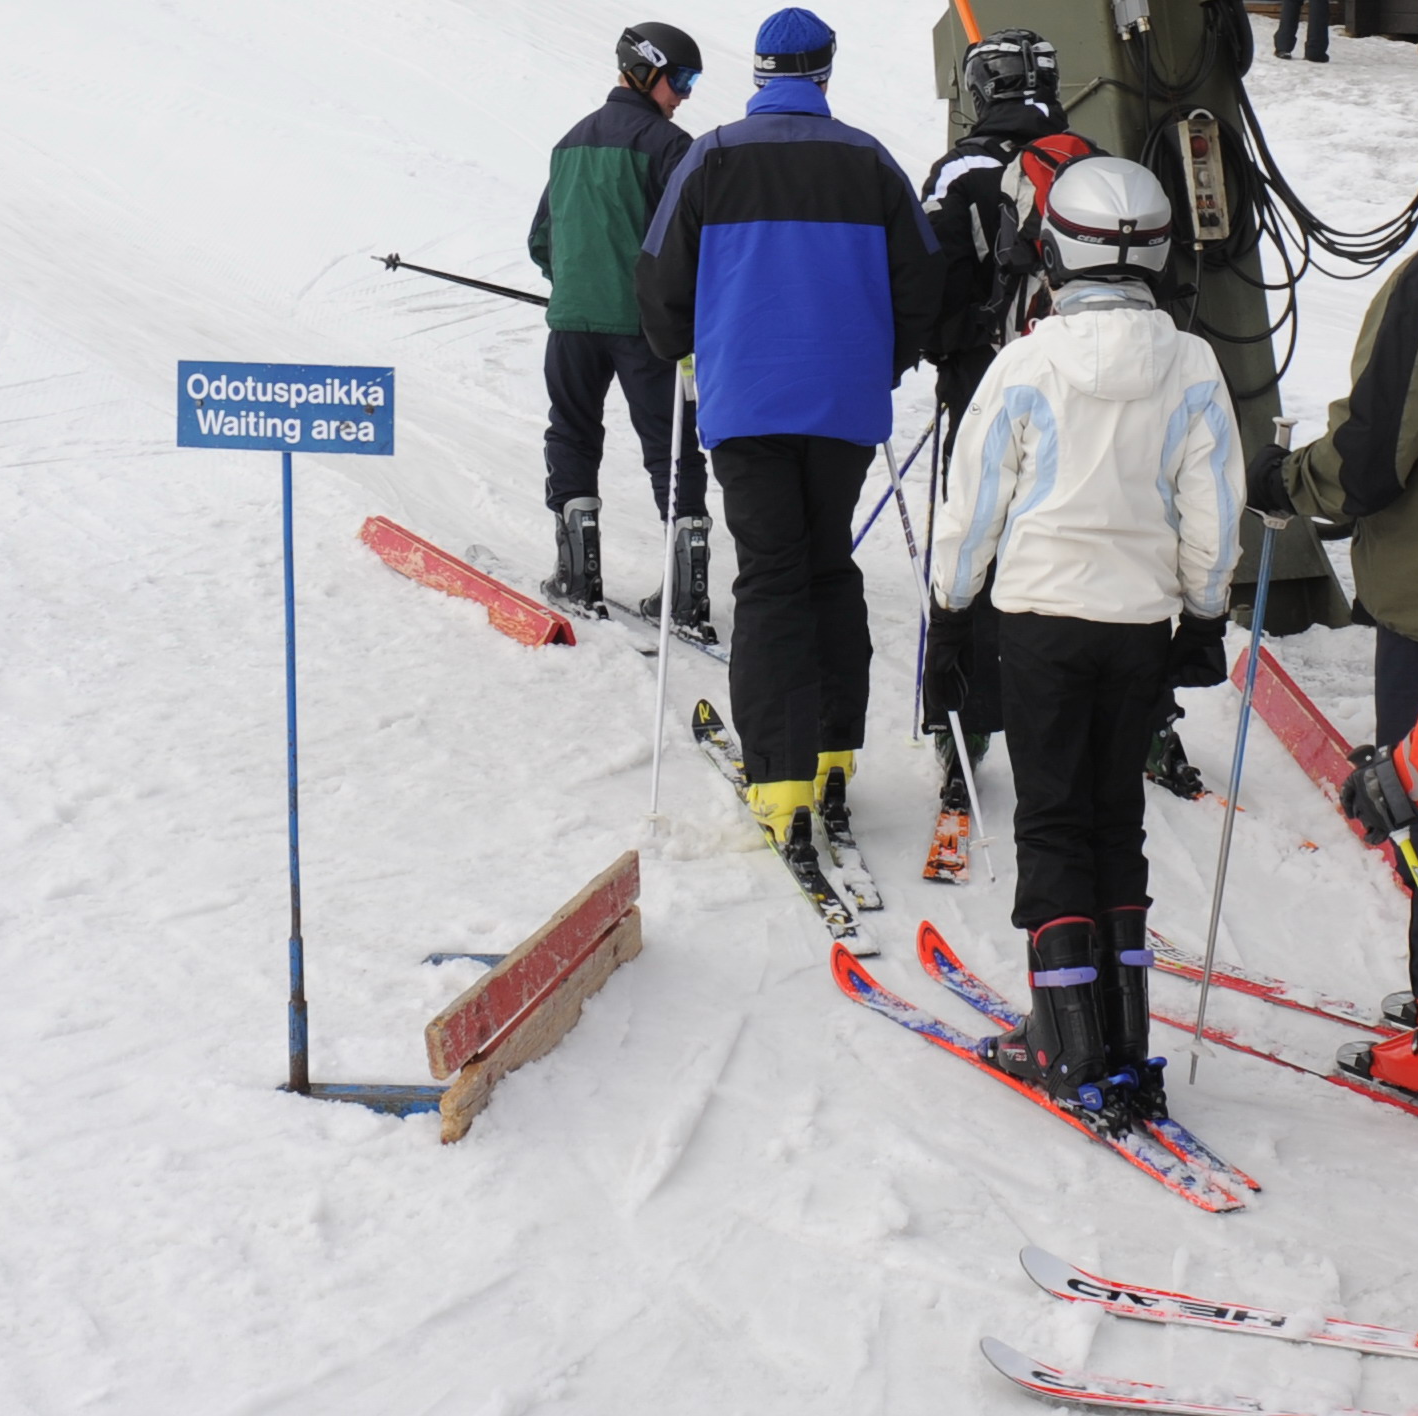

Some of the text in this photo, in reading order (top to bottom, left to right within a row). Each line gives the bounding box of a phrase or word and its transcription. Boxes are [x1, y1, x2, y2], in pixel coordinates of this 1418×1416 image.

[186, 373, 385, 409] Odotuspaikka
[196, 409, 375, 444] Waiting area
